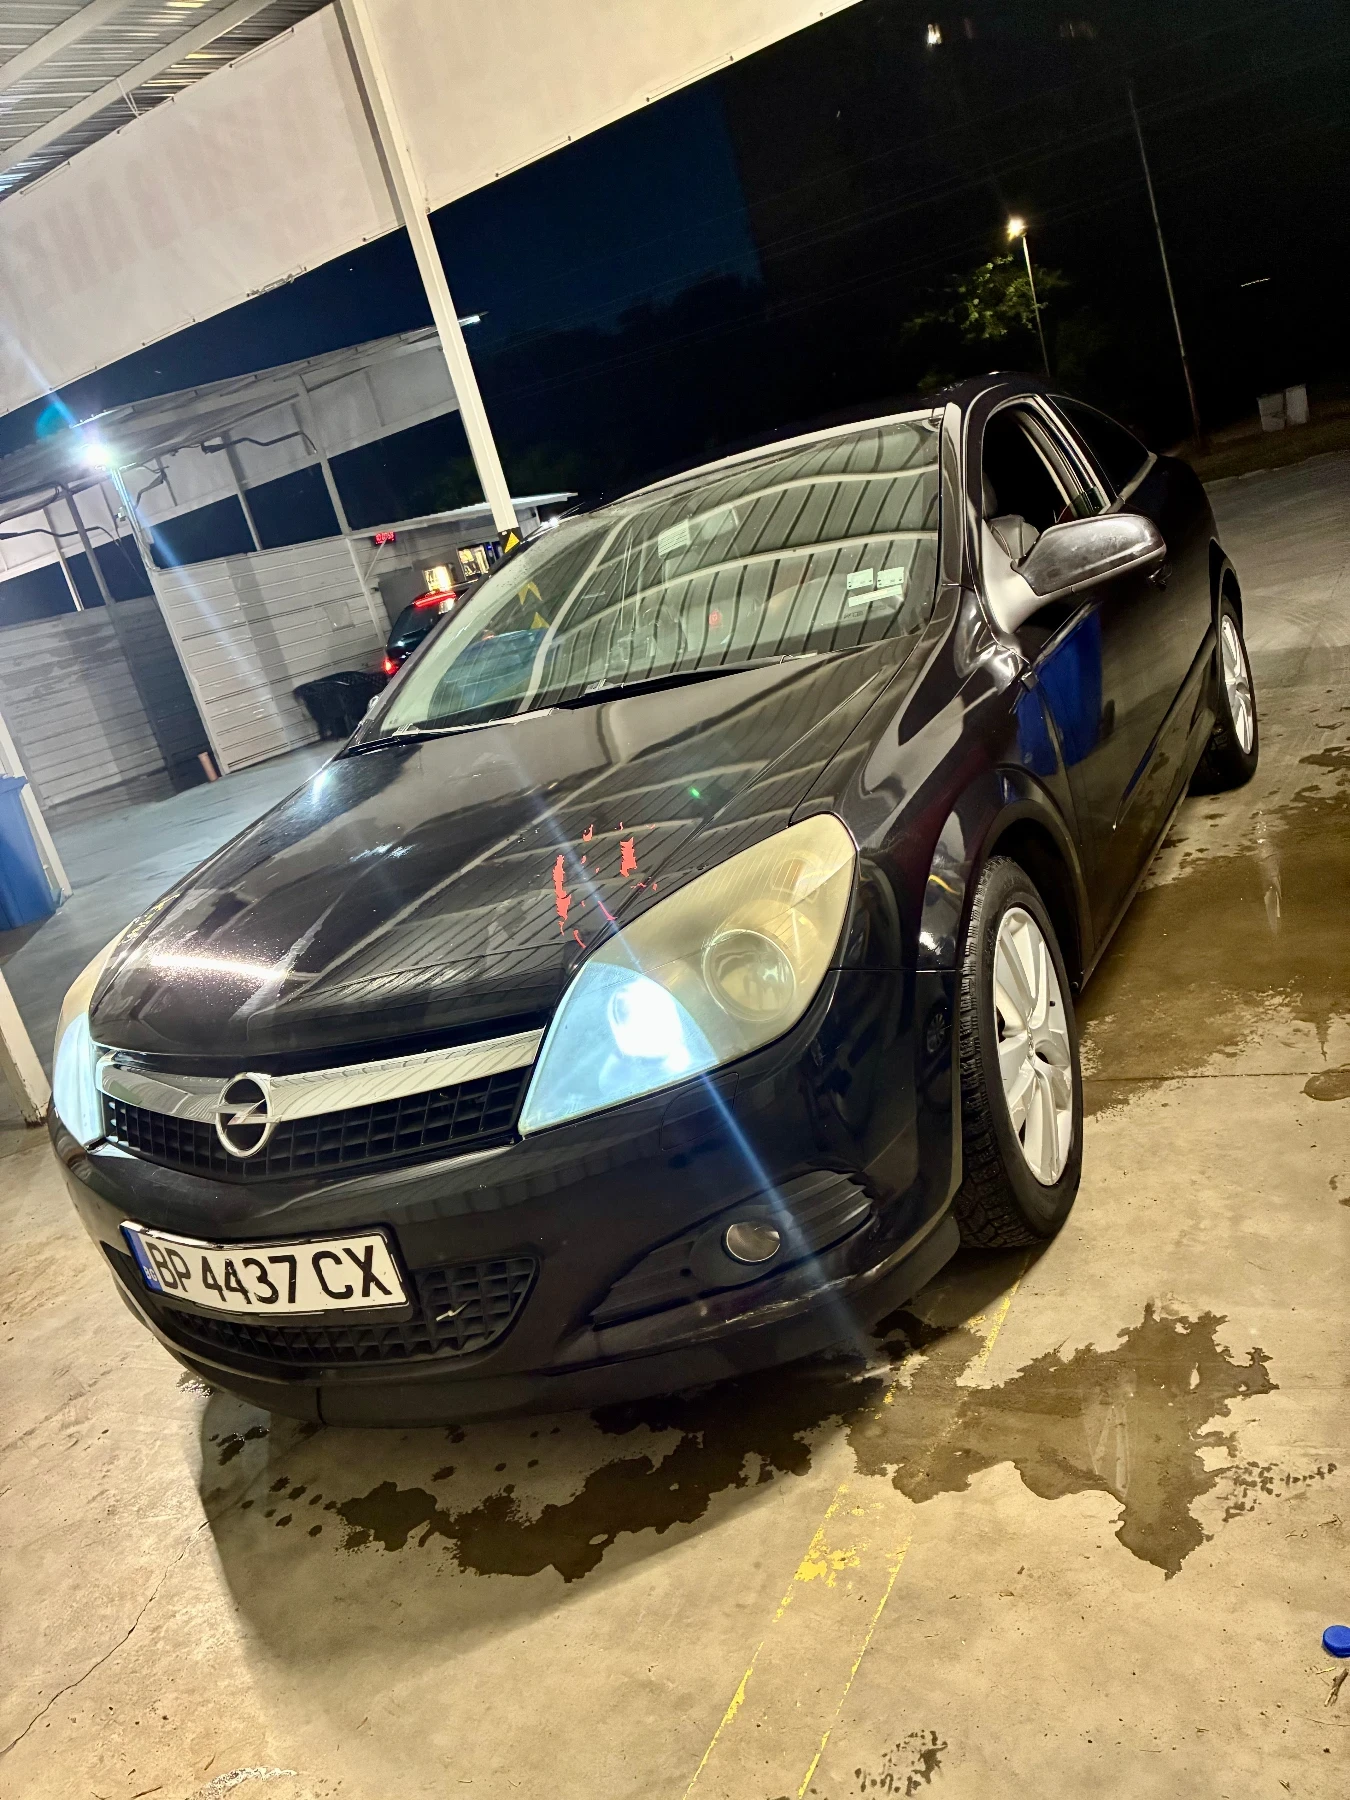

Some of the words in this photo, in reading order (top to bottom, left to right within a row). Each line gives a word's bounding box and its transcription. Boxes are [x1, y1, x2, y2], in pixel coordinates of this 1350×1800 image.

[142, 1265, 157, 1281] BG
[145, 1241, 191, 1293] BP
[201, 1254, 297, 1304] 4437
[311, 1245, 393, 1300] CX
